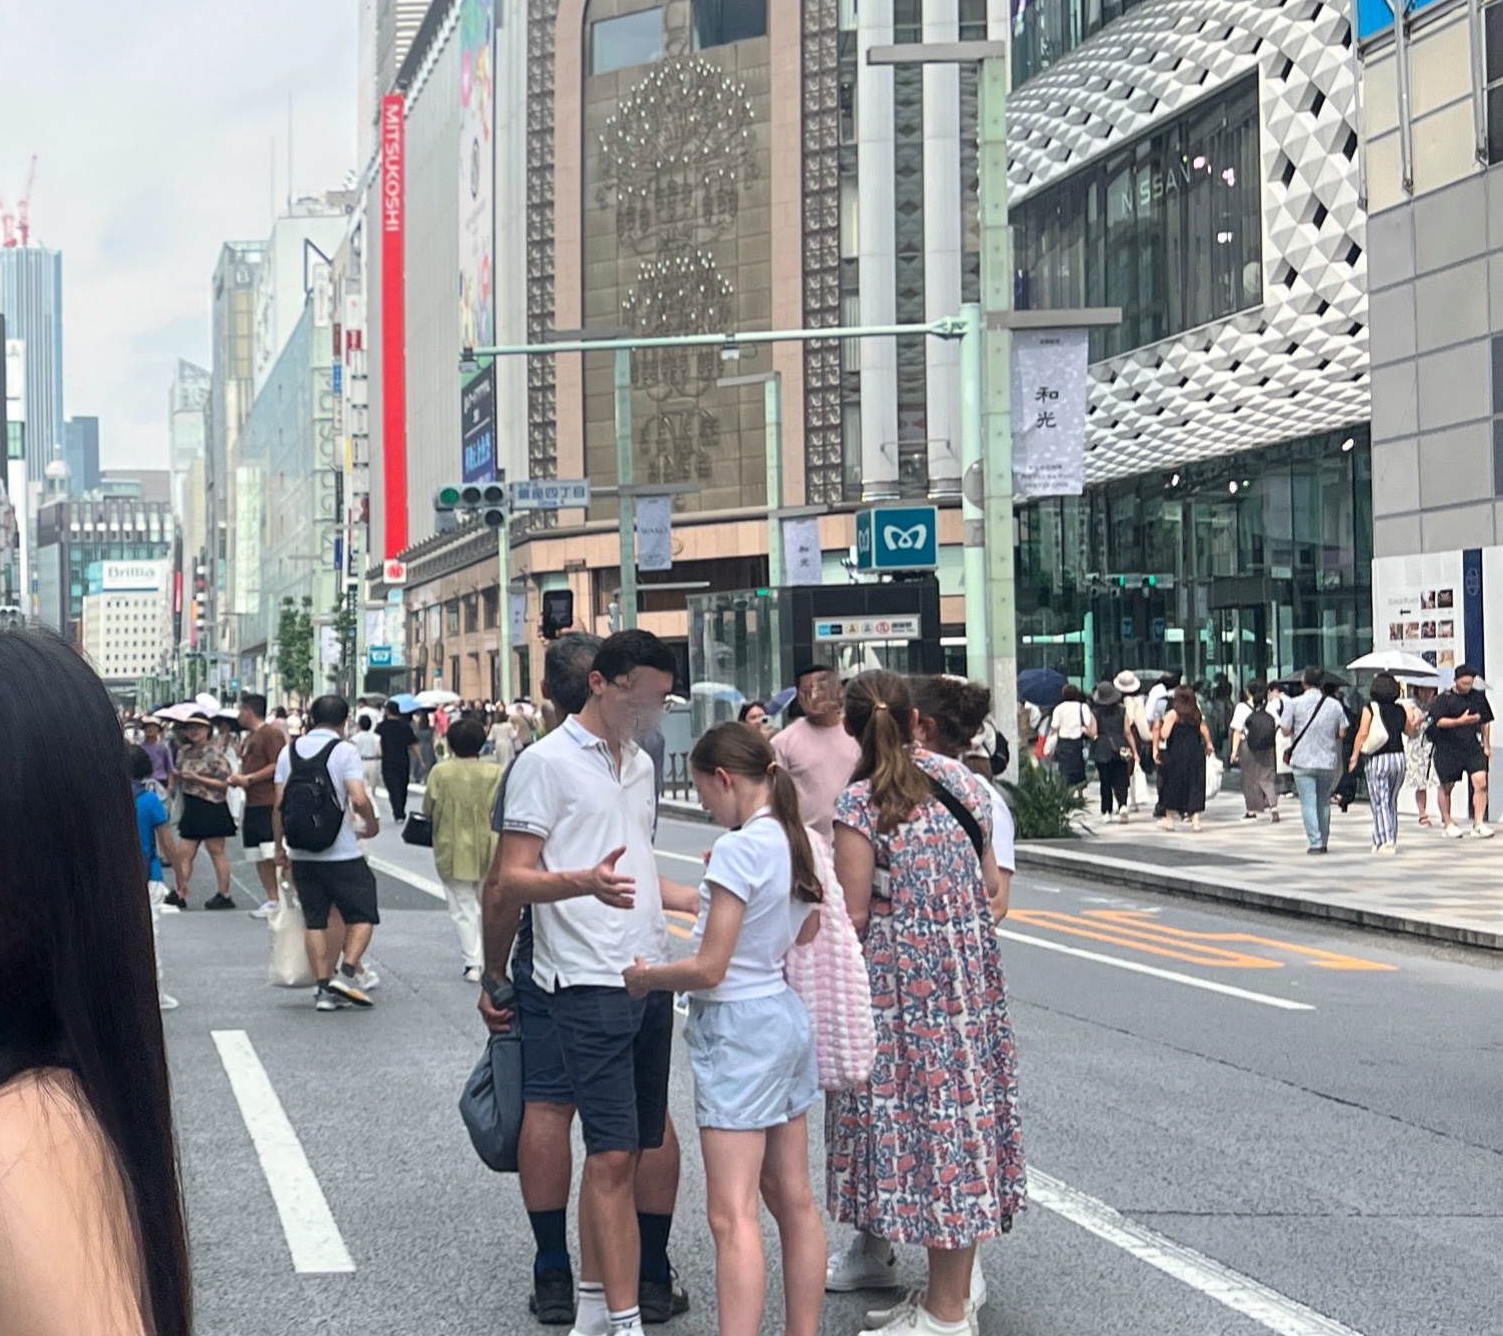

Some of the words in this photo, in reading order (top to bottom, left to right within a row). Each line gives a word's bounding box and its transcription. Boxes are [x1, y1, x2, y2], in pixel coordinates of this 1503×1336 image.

[385, 104, 399, 232] MITSUKOSHI
[1121, 162, 1191, 217] NSSAN
[1035, 386, 1059, 428] 和光
[108, 566, 155, 578] Brillia
